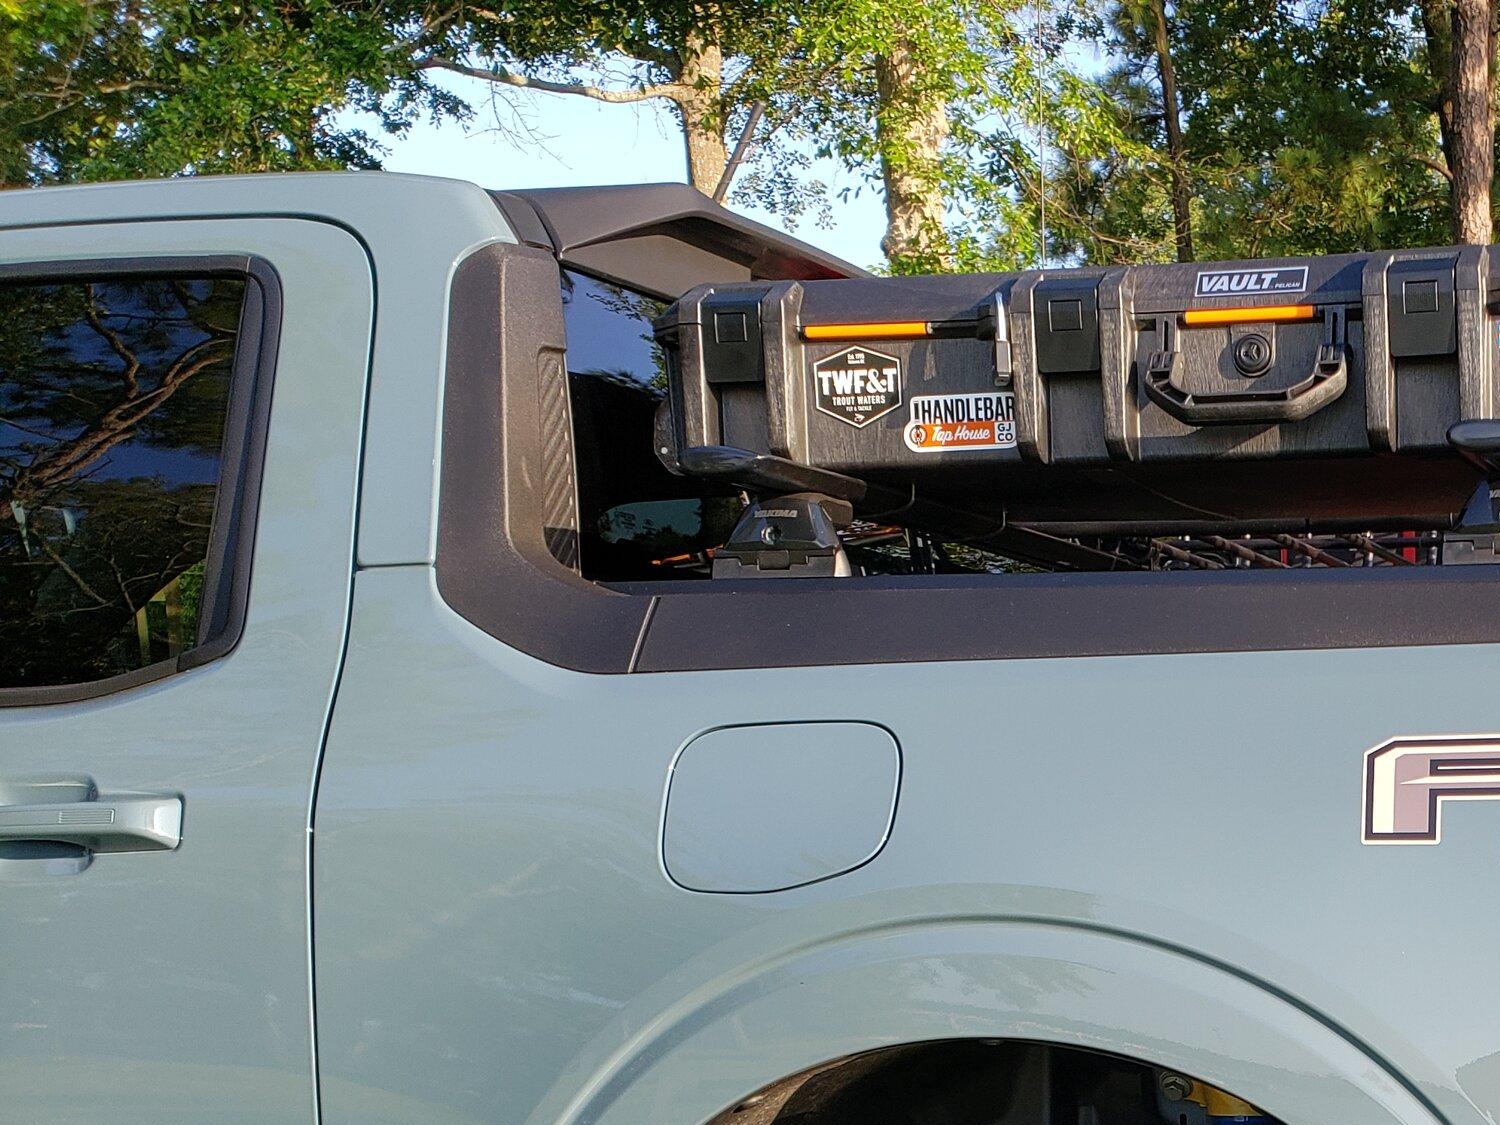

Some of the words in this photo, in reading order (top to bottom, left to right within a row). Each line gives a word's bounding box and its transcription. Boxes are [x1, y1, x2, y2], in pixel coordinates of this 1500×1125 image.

[1202, 273, 1278, 293] VAULT
[818, 367, 897, 395] TWF&T
[832, 396, 855, 406] TROUT
[857, 395, 886, 405] WATERS
[921, 396, 1015, 425] HANDLEBAR
[932, 426, 954, 445] Tap
[954, 425, 991, 440] House
[998, 423, 1011, 432] GJ
[998, 433, 1013, 442] CO
